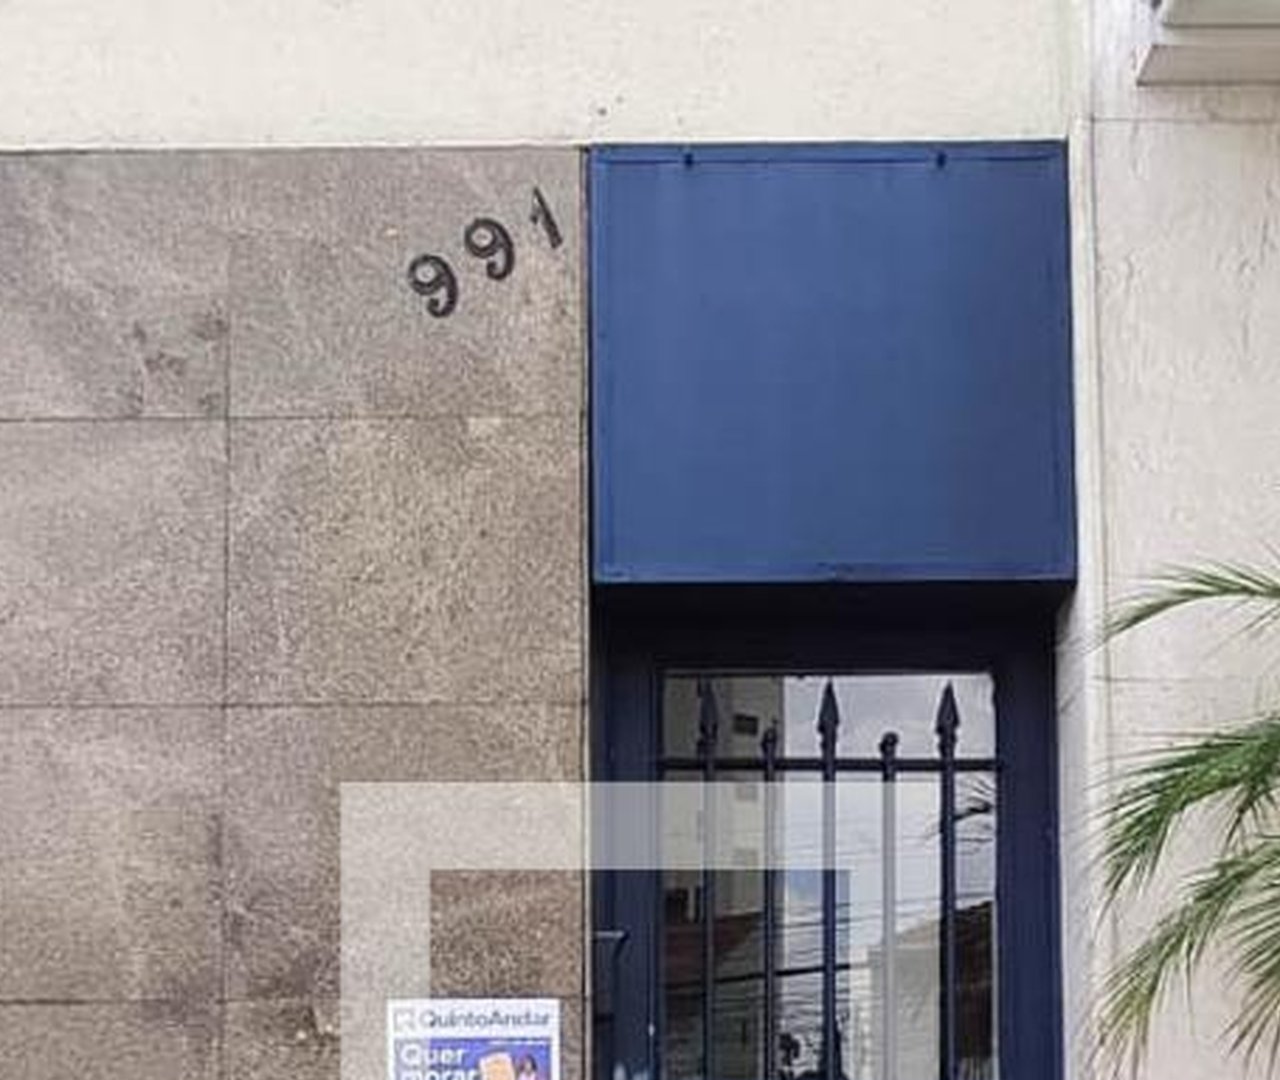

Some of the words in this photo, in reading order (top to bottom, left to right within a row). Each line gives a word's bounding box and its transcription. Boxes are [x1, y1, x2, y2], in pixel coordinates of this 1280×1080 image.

[407, 186, 563, 318] 991
[419, 1010, 550, 1028] QuintoAndar
[400, 1043, 466, 1066] Quer
